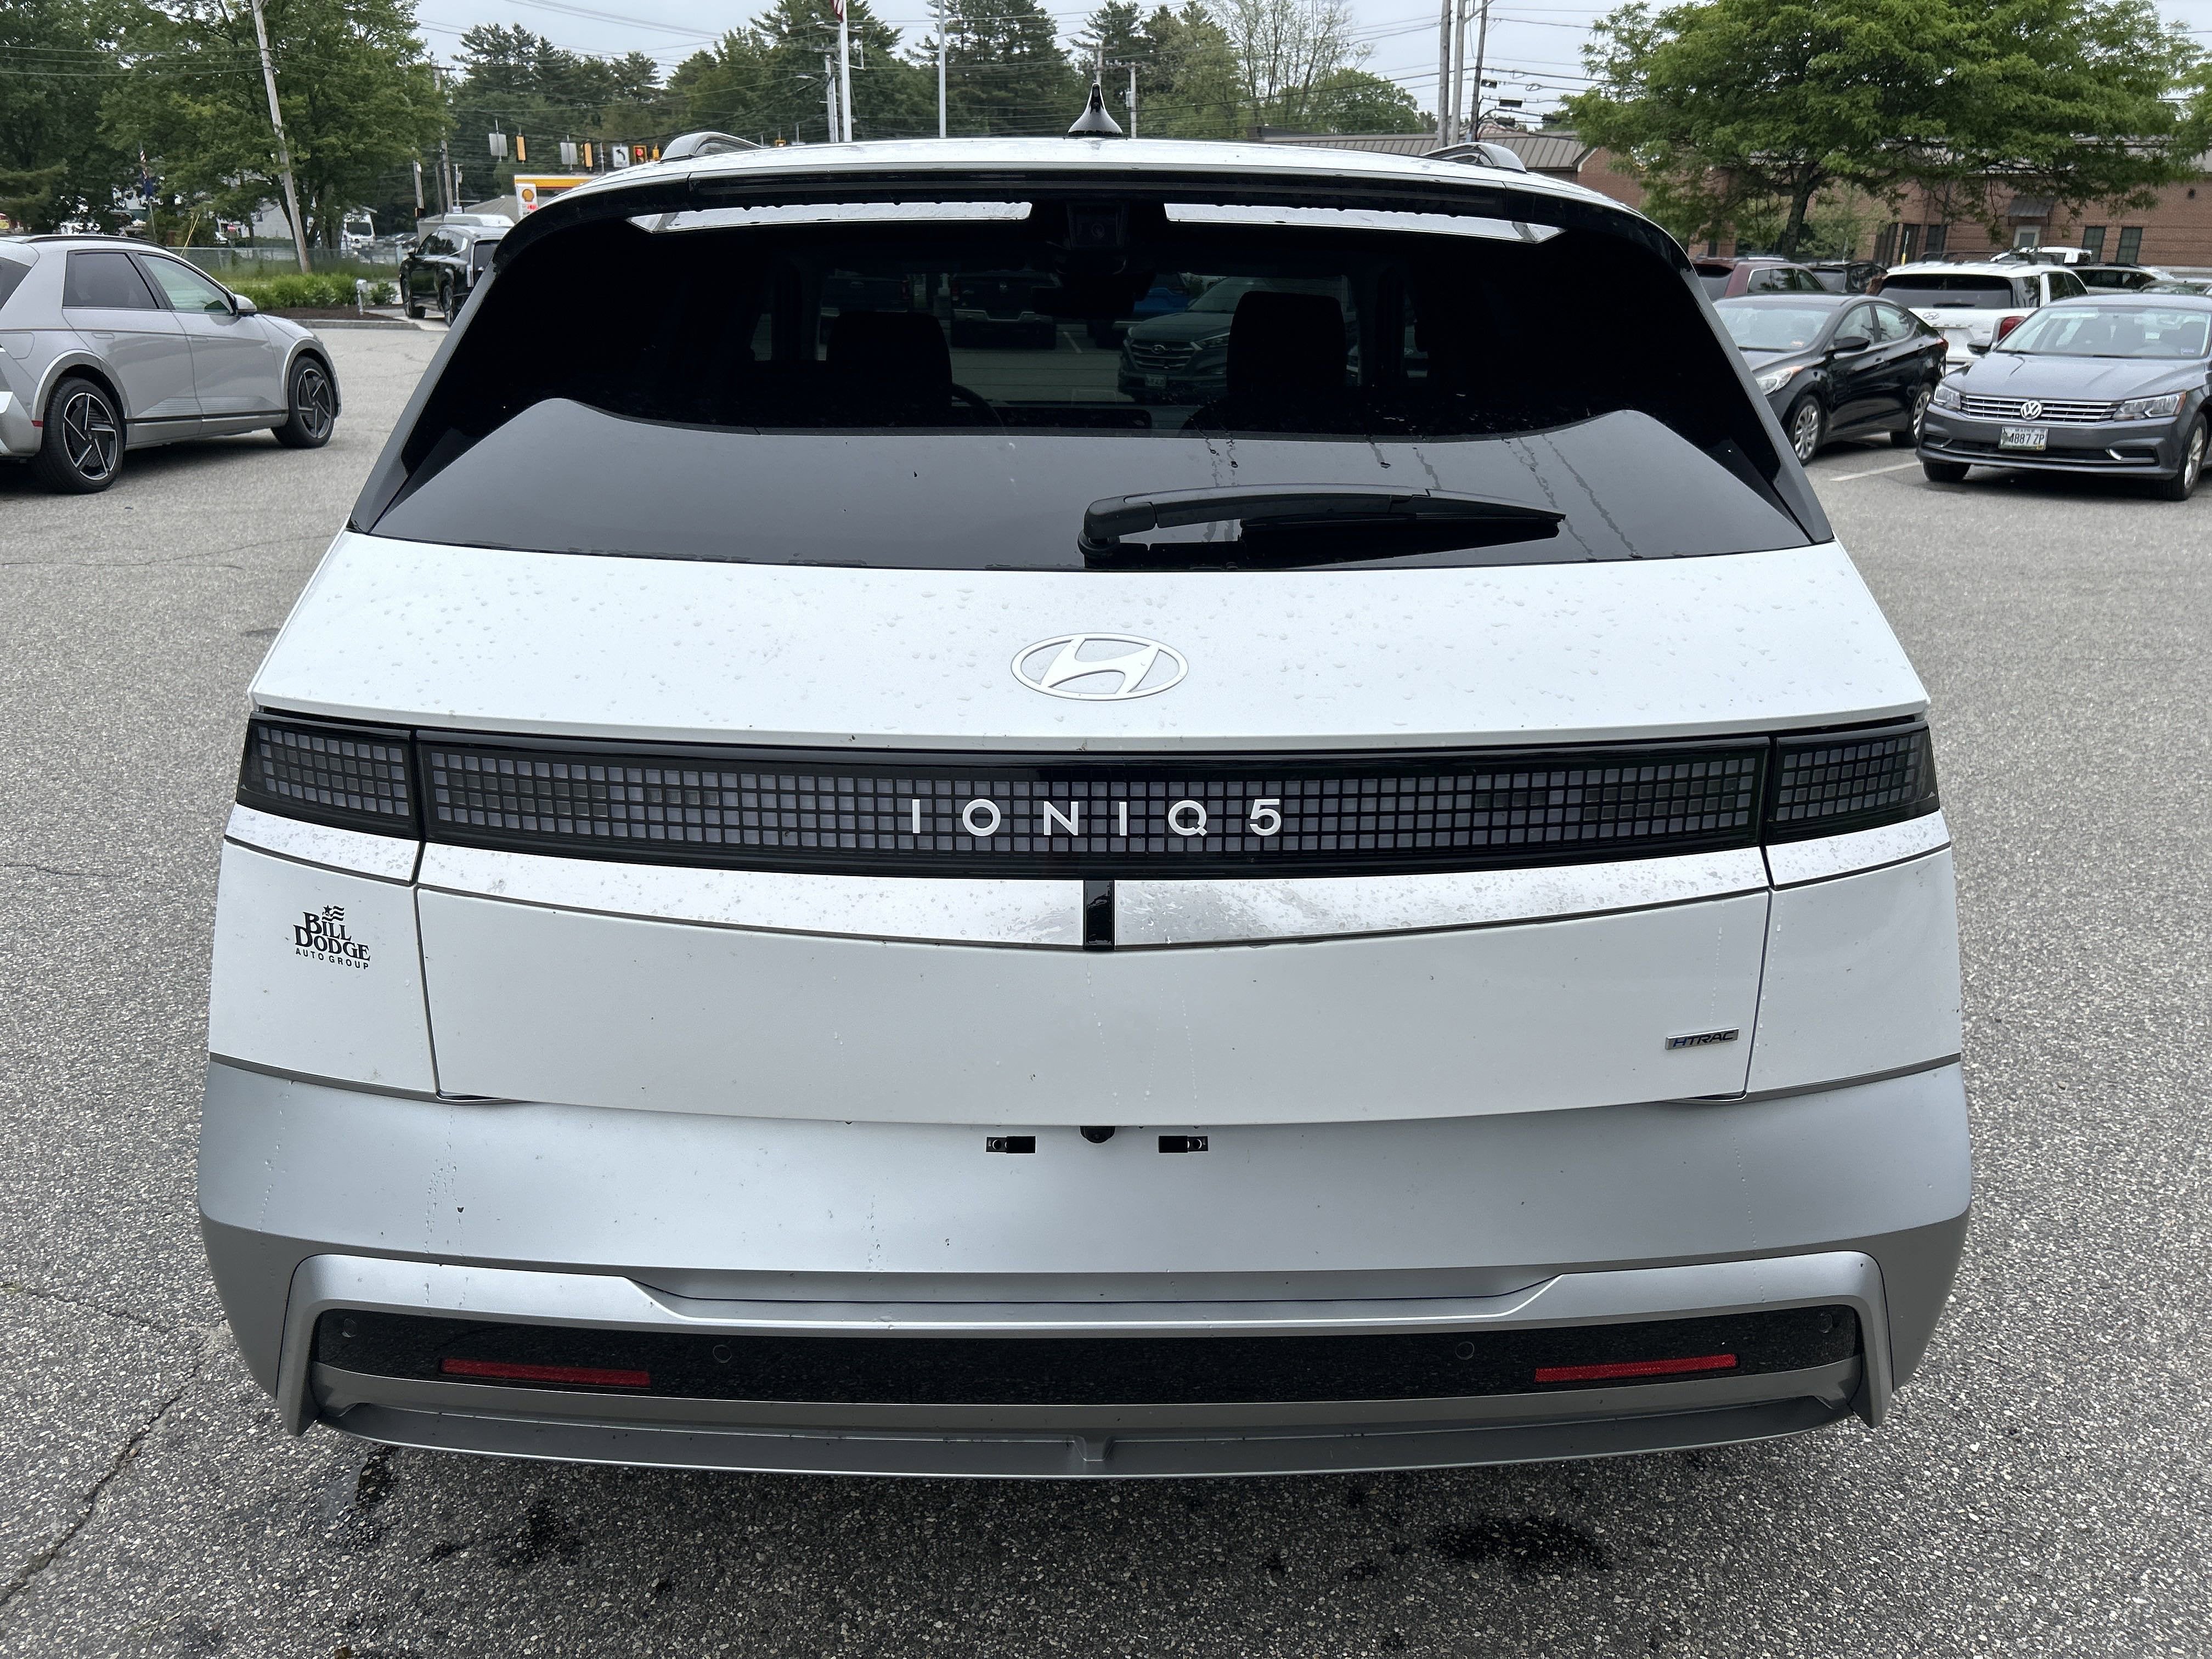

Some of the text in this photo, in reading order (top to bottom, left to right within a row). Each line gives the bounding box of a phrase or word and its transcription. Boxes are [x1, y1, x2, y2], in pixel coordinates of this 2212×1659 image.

[912, 798, 1280, 837] IONIQ 5
[303, 911, 351, 941] BILL
[293, 924, 371, 961] DODGE
[296, 947, 369, 969] AUTO GROUP
[1673, 1031, 1734, 1047] HTRAC
